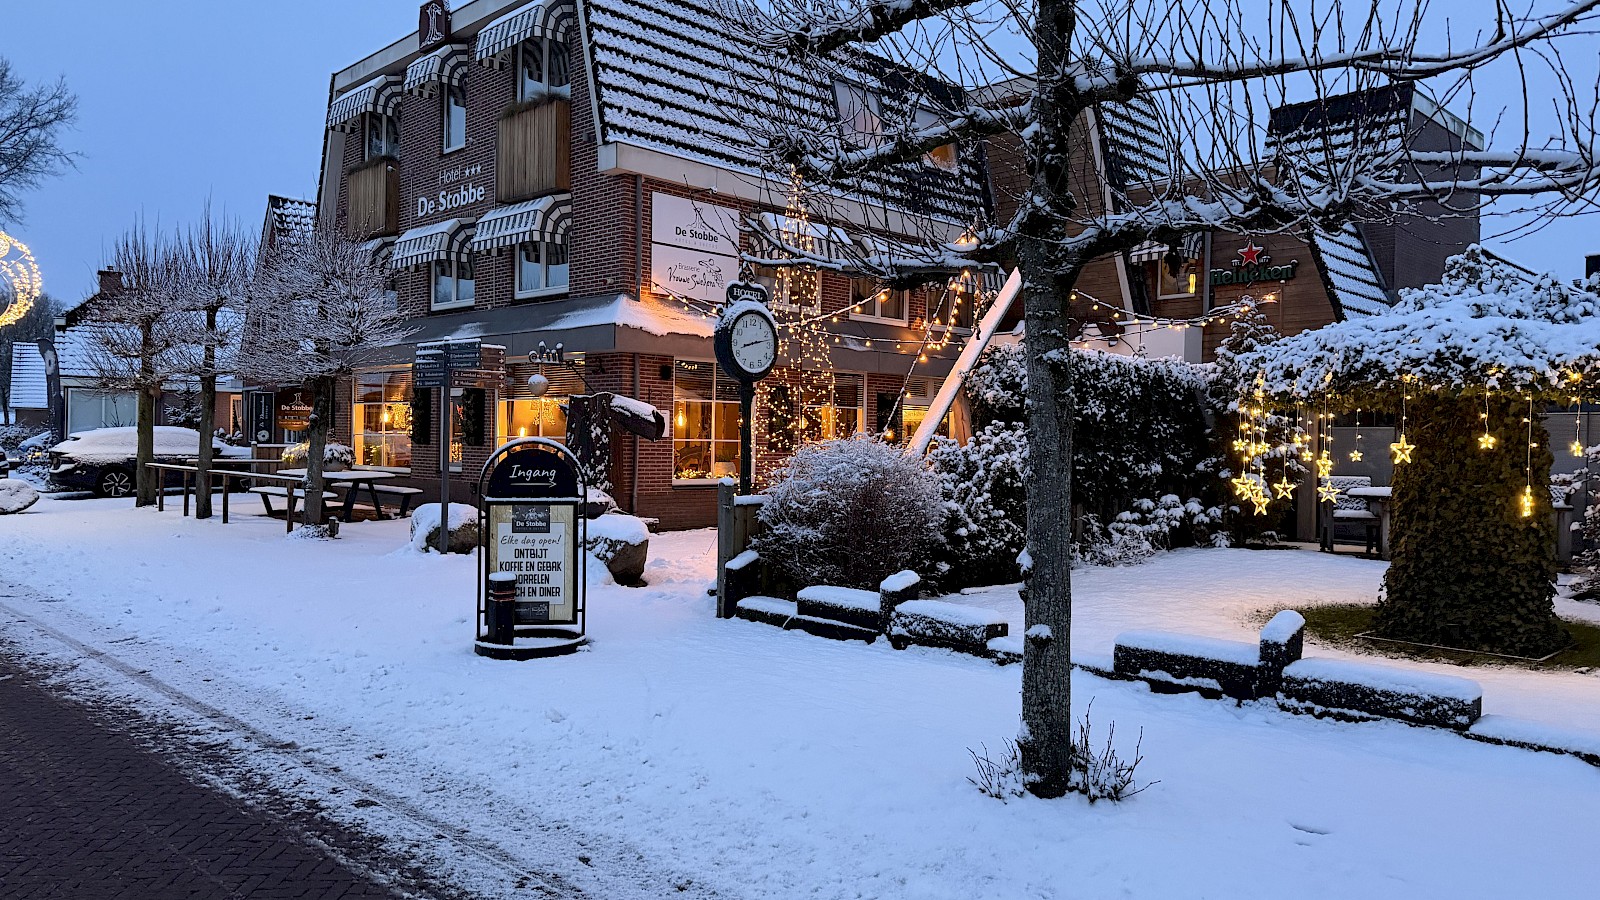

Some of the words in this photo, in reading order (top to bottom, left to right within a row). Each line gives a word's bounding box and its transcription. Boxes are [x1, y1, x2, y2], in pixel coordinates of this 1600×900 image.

[439, 165, 461, 186] Hotel
[418, 197, 435, 217] De
[438, 183, 485, 211] Stobbe
[675, 226, 687, 236] De
[689, 229, 719, 242] Stobbe
[678, 262, 700, 272] Brasserie
[667, 265, 690, 283] Vrouwe
[1210, 264, 1293, 285] Heineken
[732, 287, 763, 300] HOTEL
[742, 320, 748, 328] 11
[749, 318, 757, 326] 12
[736, 328, 743, 336] 10
[508, 464, 556, 481] Ingang
[500, 535, 519, 545] Elke
[521, 535, 536, 547] dag
[538, 534, 562, 547] open!
[514, 548, 549, 559] ONTBIJT
[499, 561, 524, 572] KOFFIE
[525, 561, 535, 572] EN
[537, 561, 562, 572] GEBAK
[527, 586, 537, 597] EN
[539, 586, 561, 597] DINER
